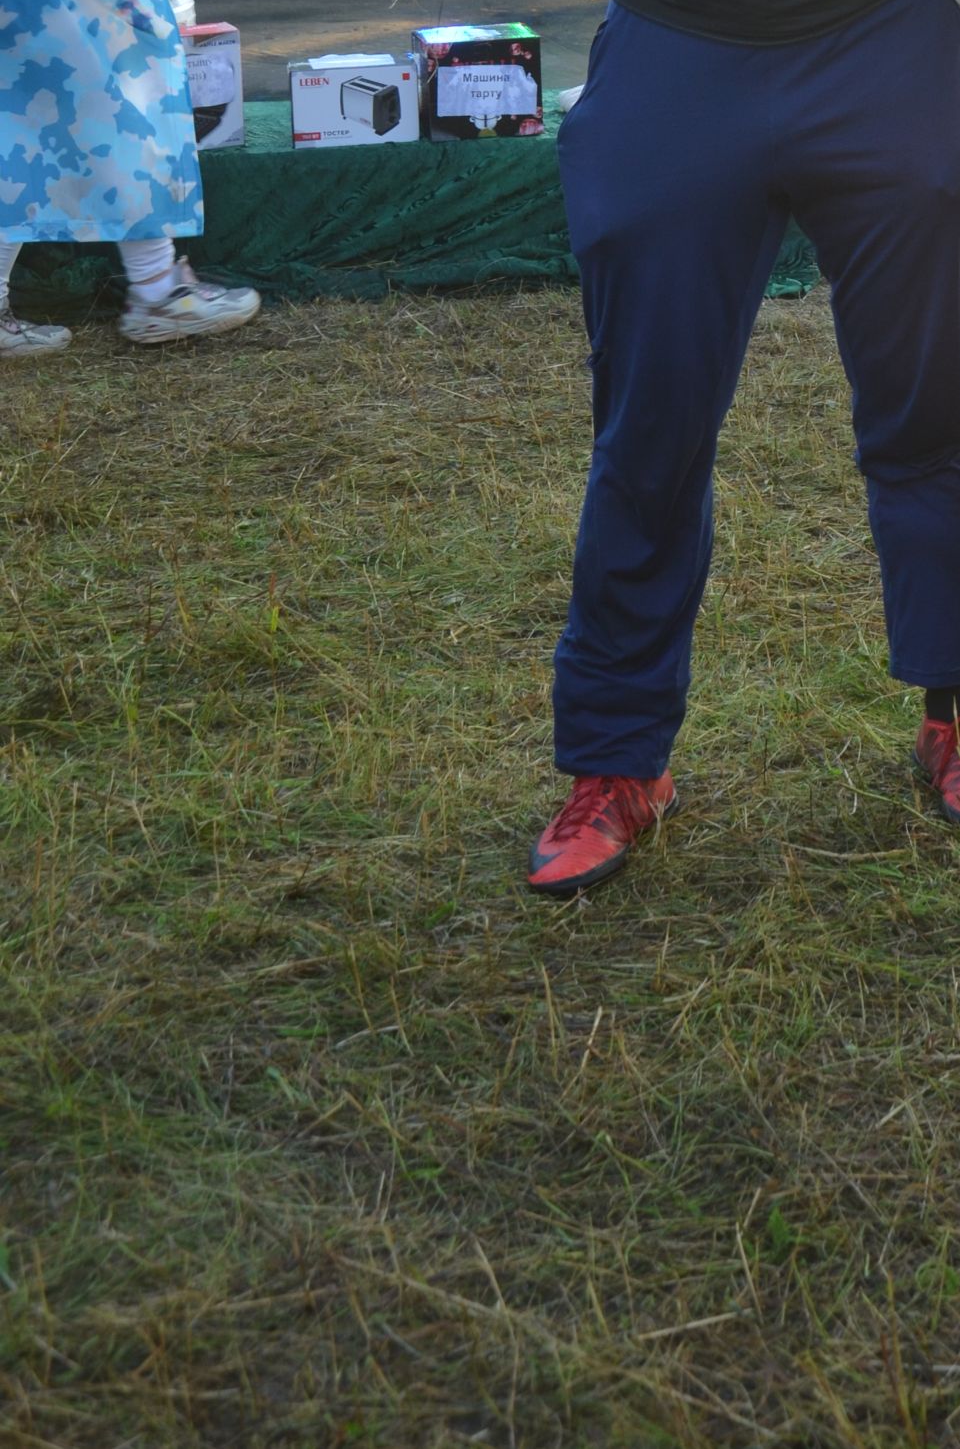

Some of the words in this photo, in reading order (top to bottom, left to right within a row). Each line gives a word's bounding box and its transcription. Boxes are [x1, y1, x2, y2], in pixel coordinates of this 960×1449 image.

[299, 77, 330, 87] LEBEN
[462, 73, 510, 83] Машина
[470, 90, 502, 100] тарту
